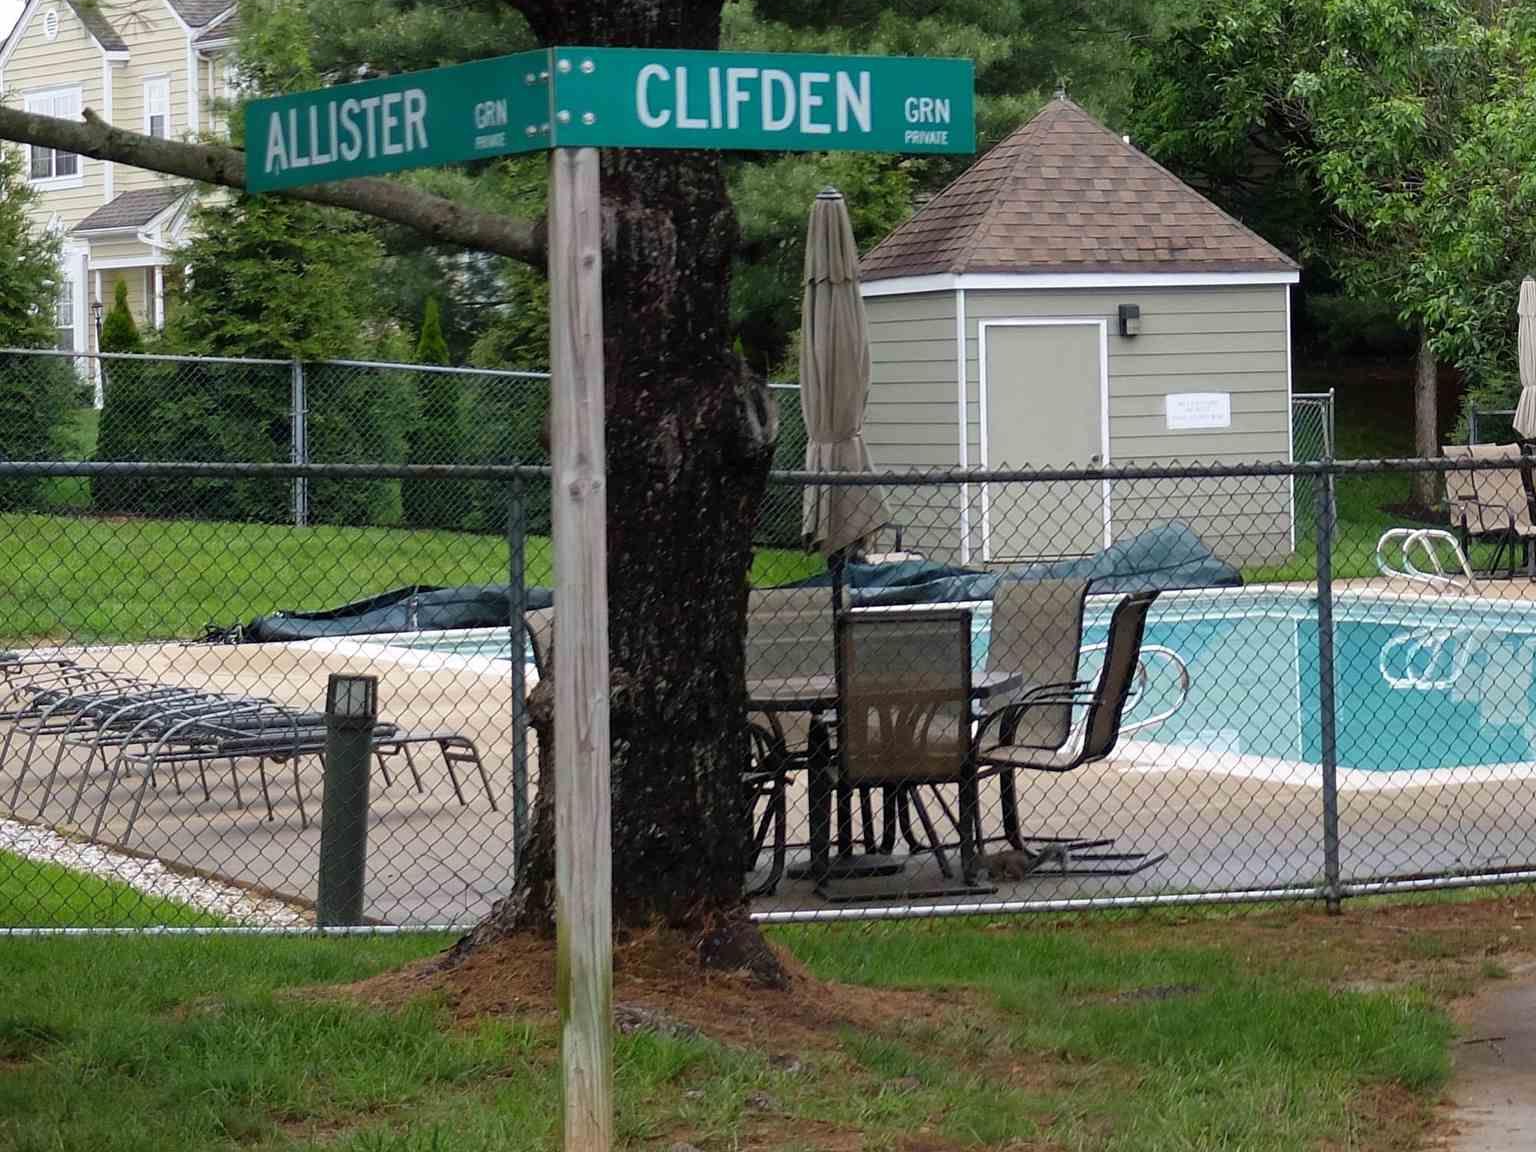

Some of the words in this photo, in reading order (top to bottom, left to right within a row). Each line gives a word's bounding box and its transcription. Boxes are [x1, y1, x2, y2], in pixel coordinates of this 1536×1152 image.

[265, 88, 428, 173] ALLISTER
[474, 98, 507, 129] GRN
[636, 63, 871, 134] CLIFDEN
[904, 96, 950, 124] GRN
[904, 130, 949, 145] PRIVATE
